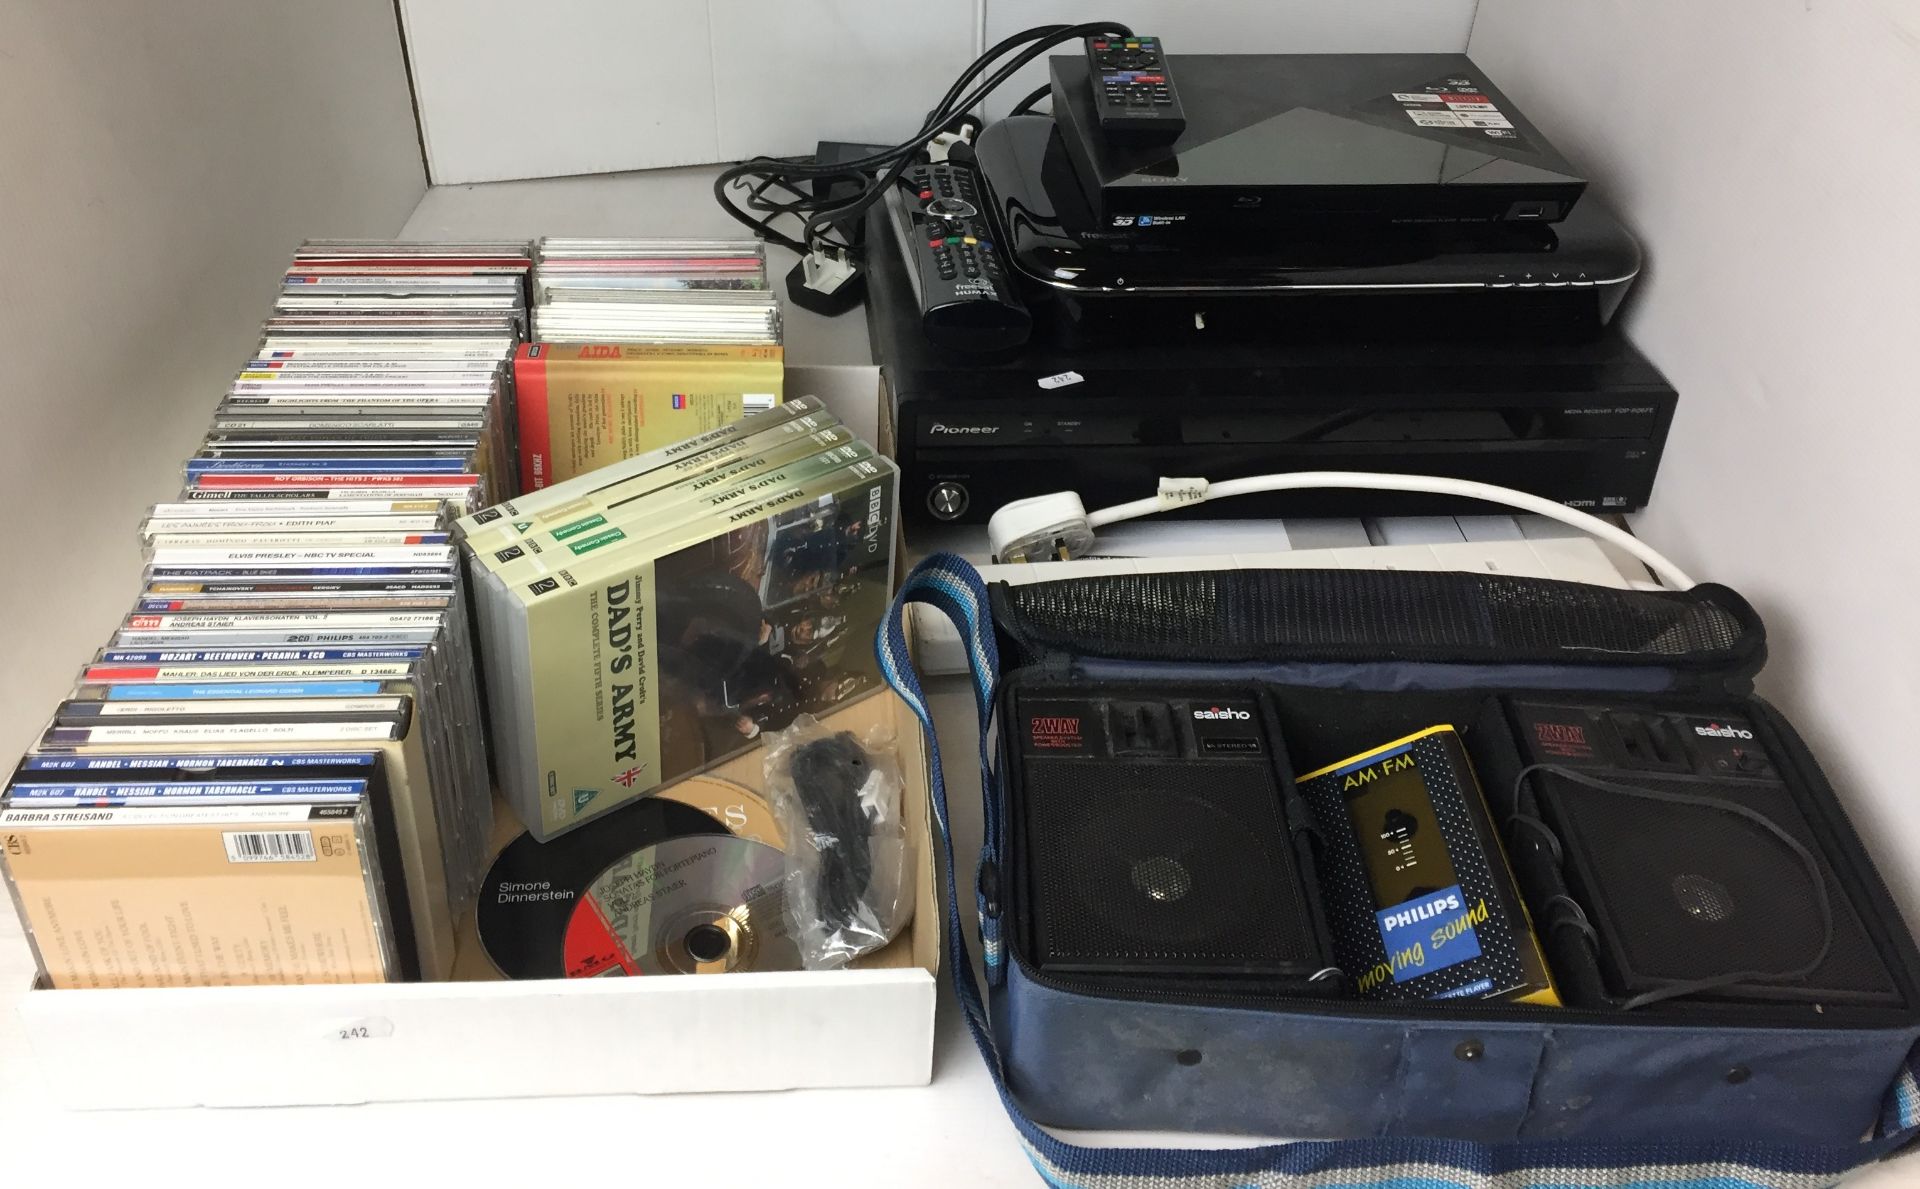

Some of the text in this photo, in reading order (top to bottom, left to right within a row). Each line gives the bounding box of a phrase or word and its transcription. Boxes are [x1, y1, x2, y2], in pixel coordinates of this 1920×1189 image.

[578, 345, 622, 359] AIDA
[929, 424, 1000, 434] Pioneer
[663, 426, 738, 457] DAD'S ARMY
[672, 440, 746, 471] DAD'S ARMY
[691, 457, 767, 492] DAD'S ARMY
[710, 473, 787, 507] DAD'S ARMY
[727, 489, 805, 523] DAD'S ARMY
[868, 486, 882, 526] BBC
[574, 531, 622, 551] Classic Comedy
[537, 577, 553, 591] 2
[589, 591, 597, 611] THE
[591, 612, 601, 659] COMPLETE
[160, 652, 197, 661] MOZART
[203, 651, 256, 660] BEETHOVEN
[262, 651, 301, 660] PERAHIA
[307, 650, 325, 659] ECO
[357, 650, 409, 658] MASTERWORKS
[606, 579, 637, 763] DAD'S ARMY
[1194, 706, 1251, 720] saisho
[1032, 718, 1079, 734] 2WAY
[1535, 723, 1586, 743] 2WAY
[1695, 722, 1753, 740] saisho
[41, 760, 59, 768] M2K
[60, 760, 76, 768] 607
[88, 759, 121, 769] HANDEL
[129, 758, 168, 768] MESSIAH
[176, 758, 214, 768] MORMON
[216, 758, 268, 767] TABERNACLE
[307, 757, 362, 765] MASTERWORKS
[29, 788, 47, 796] M2K
[49, 788, 65, 796] 607
[74, 786, 107, 796] HANDEL
[116, 786, 155, 796] MESSIAH
[163, 785, 203, 796] MORMON
[204, 784, 257, 795] TABERNACLE
[297, 785, 353, 793] MASTERWORKS
[5, 813, 50, 822] BARBRA
[51, 812, 114, 822] STREISAND
[1380, 832, 1390, 840] 100
[500, 881, 551, 893] Simone
[498, 889, 574, 904] Dinnerstein
[1384, 894, 1460, 932] PHILIPS
[1357, 898, 1490, 994] moving sound
[1465, 981, 1491, 996] PLAYER
[339, 1027, 370, 1040] 242
